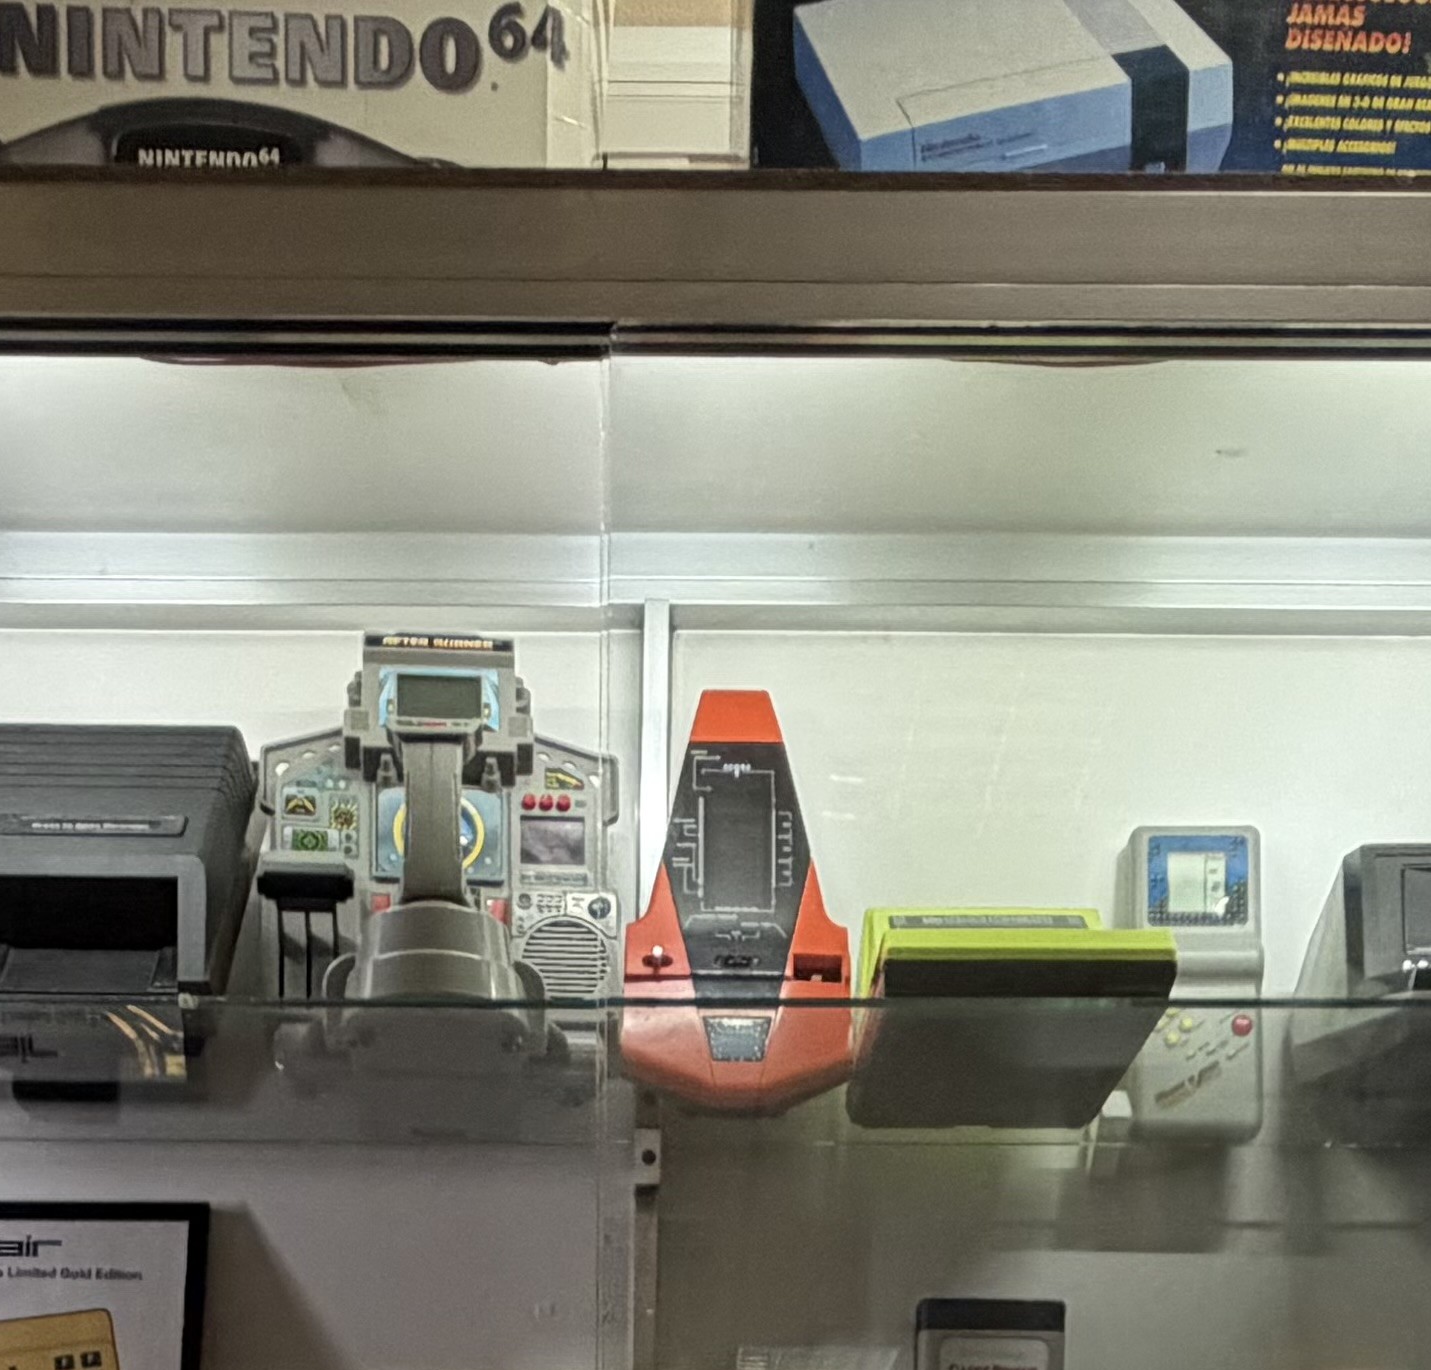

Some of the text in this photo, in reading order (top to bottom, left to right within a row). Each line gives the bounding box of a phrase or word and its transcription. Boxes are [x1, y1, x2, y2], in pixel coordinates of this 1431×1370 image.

[7, 1268, 57, 1281] Limited
[60, 1268, 92, 1281] Gold
[95, 1269, 143, 1282] Edition
